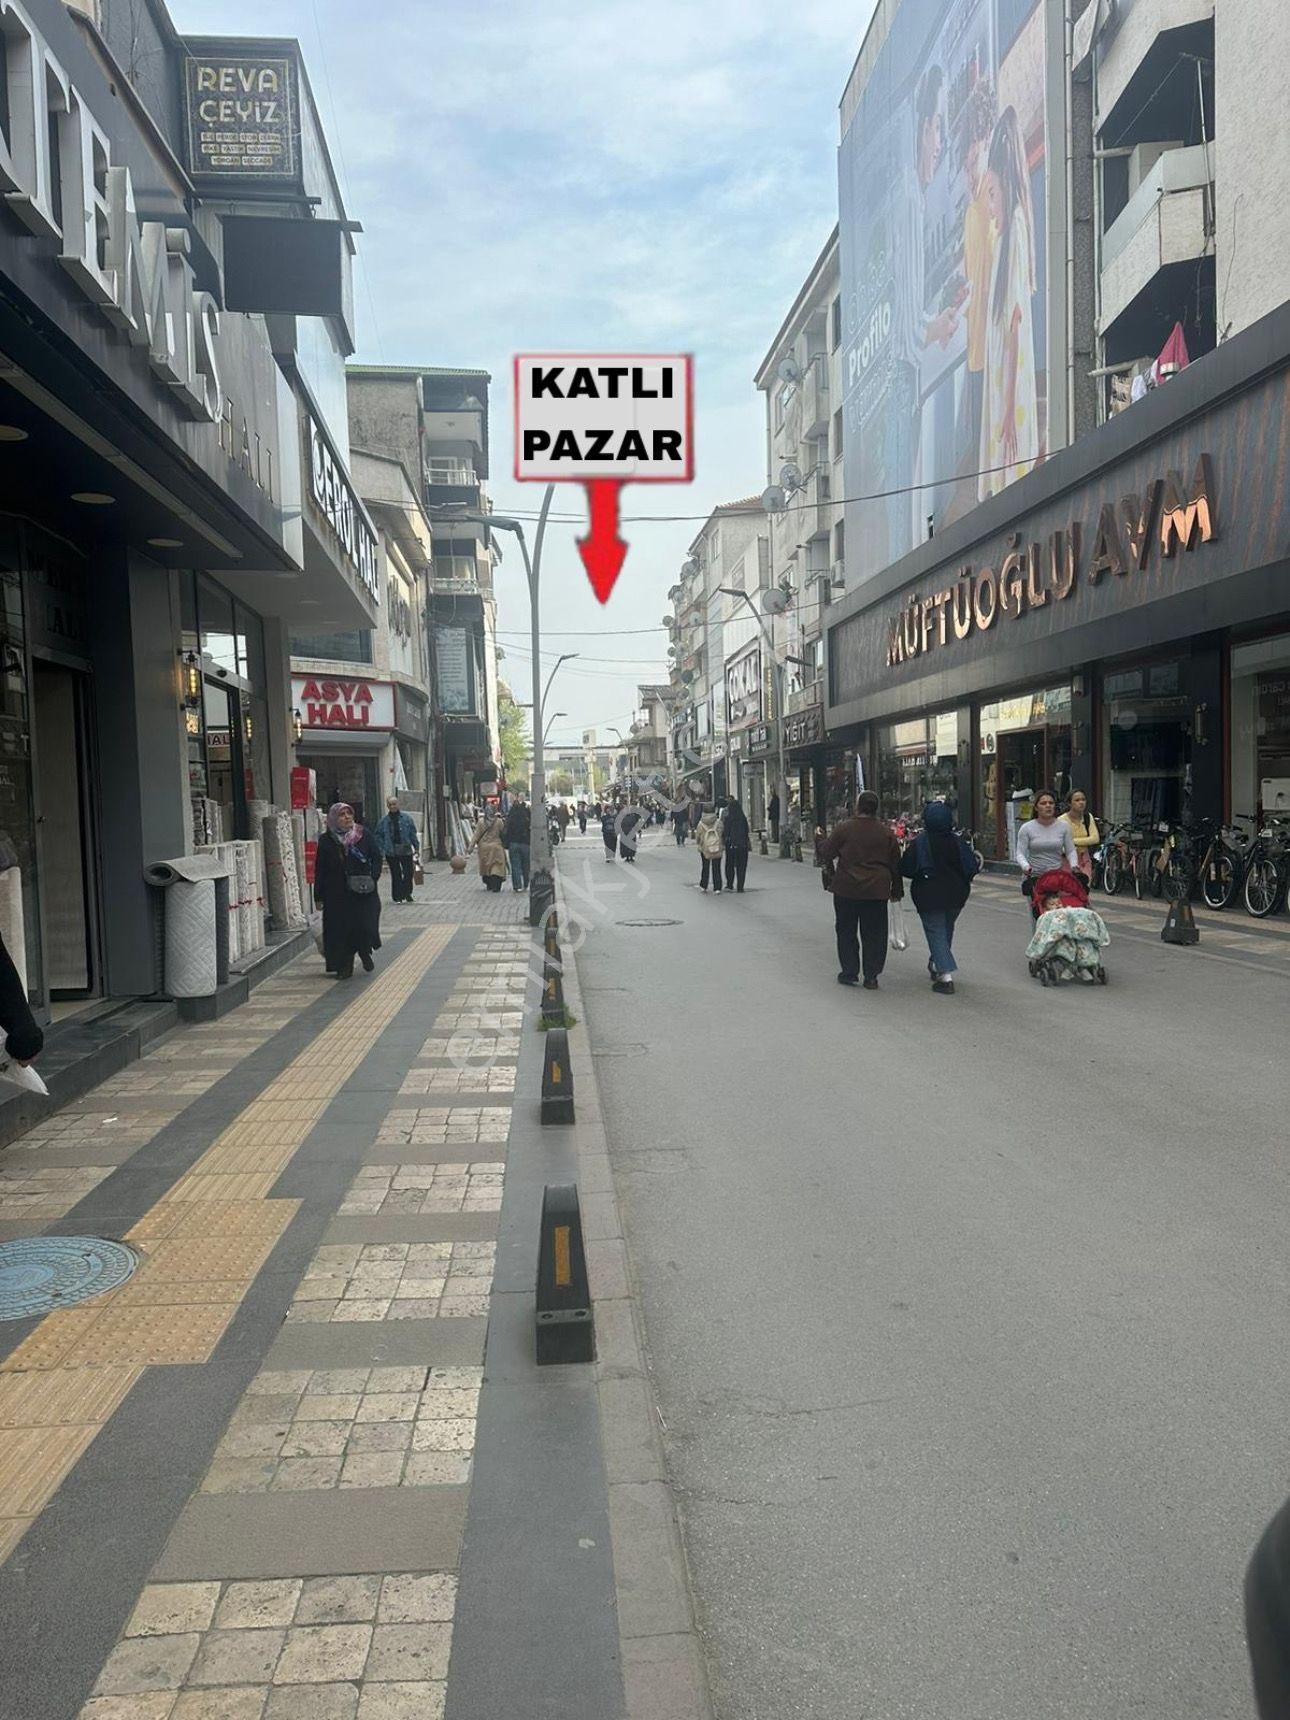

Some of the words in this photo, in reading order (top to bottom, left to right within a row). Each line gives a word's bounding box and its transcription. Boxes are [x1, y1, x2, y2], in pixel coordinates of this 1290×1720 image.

[198, 67, 278, 93] REVA
[199, 99, 279, 127] ÇEYİZ
[218, 396, 274, 503] HALI
[887, 521, 1081, 667] MÜFTÜOĞLU
[1088, 453, 1219, 587] AVM
[301, 679, 374, 704] ASYA
[307, 703, 369, 726] HALI
